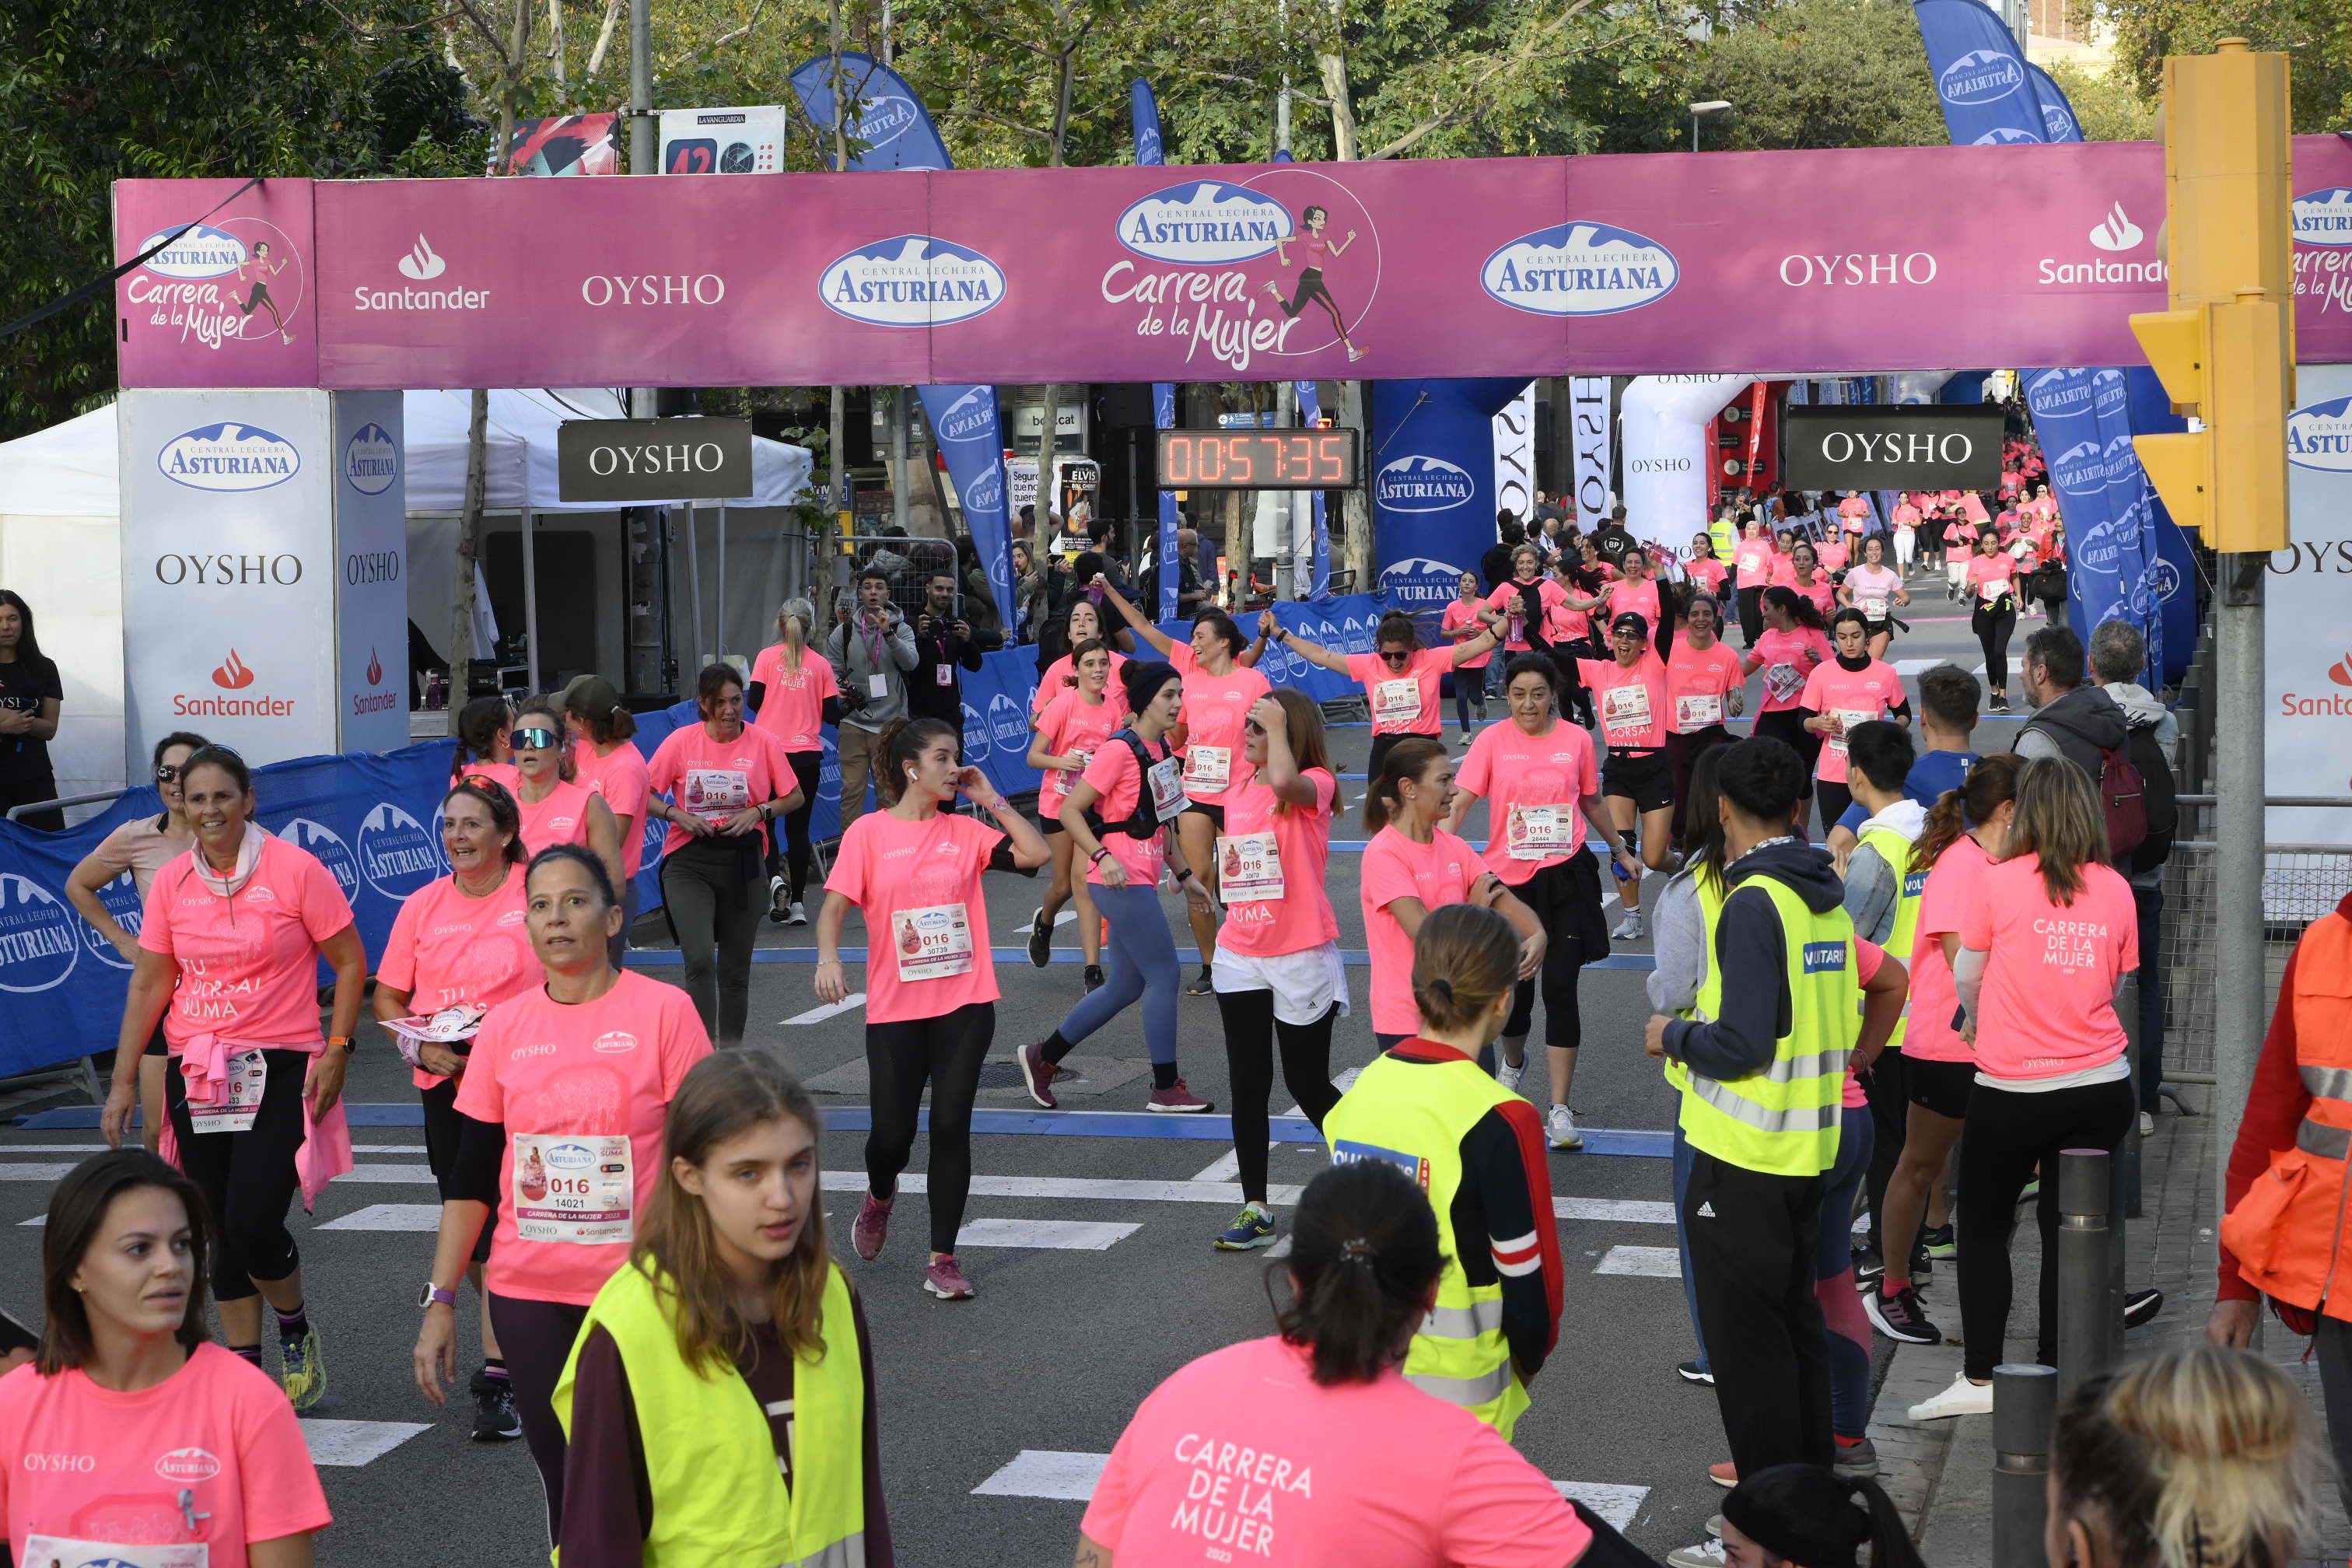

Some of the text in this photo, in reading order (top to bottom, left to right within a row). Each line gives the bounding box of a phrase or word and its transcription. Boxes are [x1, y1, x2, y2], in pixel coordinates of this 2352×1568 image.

[1157, 208, 1275, 219] CENTRAL LECHERA
[1131, 212, 1279, 243] ASTURIANA
[1527, 252, 1657, 265] CENTRAL LECHERA
[863, 265, 985, 276] CENTRAL LECHERA
[1496, 257, 1664, 293] ASTURIANA
[1780, 252, 1937, 287] OYSHO
[2039, 257, 2168, 285] Santand
[128, 275, 219, 304] Carrera
[582, 274, 725, 306] OYSHO
[834, 269, 991, 303] ASTURIANA
[1102, 260, 1248, 304] Carrera
[2311, 274, 2325, 295] la
[355, 286, 490, 310] Santander
[151, 302, 254, 349] de la Mujer
[1138, 299, 1301, 371] de la Mujer
[1169, 436, 1342, 481] 00:57:35
[1822, 432, 1972, 465] OYSHO
[169, 448, 291, 474] ASTURIANA
[349, 450, 394, 478] ASTURIANA
[589, 443, 724, 477] OYSHO
[1632, 457, 1691, 474] OYSHO
[1072, 471, 1096, 481] ELVIS
[1014, 484, 1027, 492] que
[1378, 478, 1466, 499] ASTURIANA
[156, 554, 303, 586] OYSHO
[347, 551, 399, 586] OYSHO
[780, 679, 806, 689] MUJER
[173, 693, 295, 717] Santander
[354, 691, 397, 716] Santander
[365, 843, 436, 880] ASTURIANA
[884, 847, 916, 859] OYSHO
[1244, 860, 1262, 870] 016
[182, 896, 217, 906] OYSHO
[1233, 905, 1272, 922] SUMA
[434, 924, 472, 934] OYSHO
[2033, 919, 2109, 939] CARRERA
[923, 933, 949, 946] 016
[2048, 935, 2094, 952] DE LA
[927, 947, 947, 955] 30739
[2042, 950, 2095, 968] MUJER
[180, 958, 206, 975] TU
[908, 968, 932, 976] OYSHO
[183, 996, 239, 1018] SUMA
[511, 1044, 556, 1060] OYSHO
[597, 1040, 635, 1049] ASTURIANA
[2022, 1059, 2064, 1070] OYSHO
[548, 1153, 592, 1164] ASTURIANA
[551, 1178, 590, 1194] 016
[555, 1199, 584, 1208] 14021
[525, 1225, 558, 1235] OYSHO
[586, 1227, 623, 1236] Santander
[23, 1453, 96, 1473] OYSHO
[161, 1460, 216, 1474] ASTURIANA
[1174, 1433, 1311, 1499] CARRERA
[1187, 1468, 1273, 1522] DE LA
[1171, 1500, 1274, 1558] MUJER
[1206, 1546, 1233, 1564] 2023
